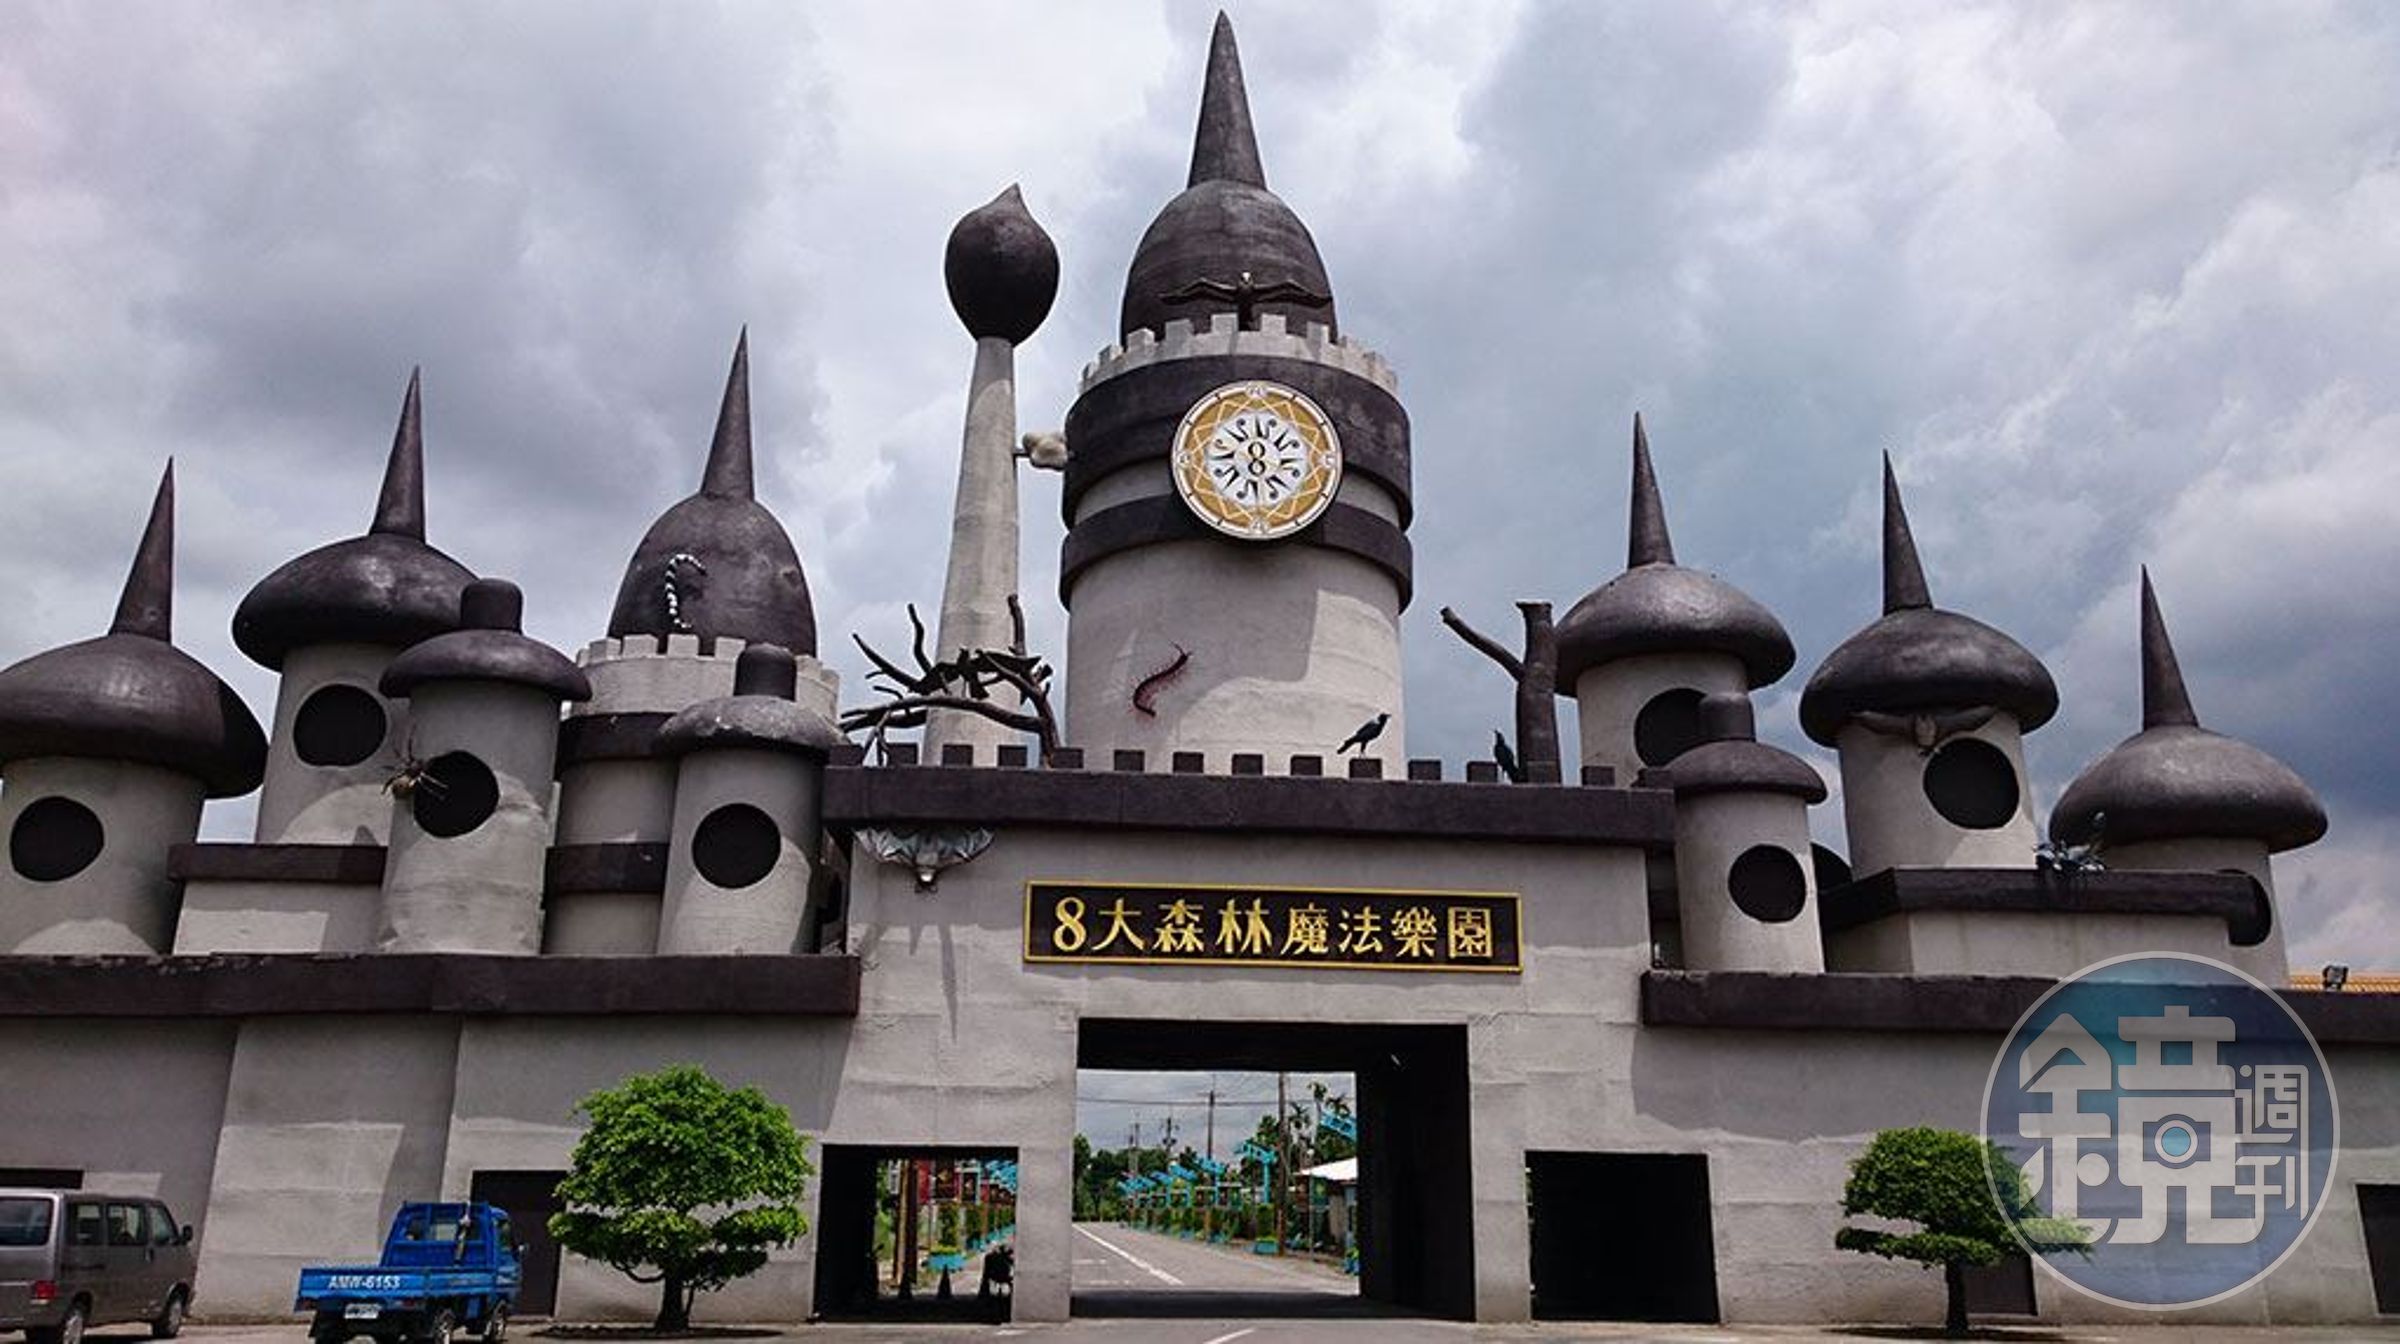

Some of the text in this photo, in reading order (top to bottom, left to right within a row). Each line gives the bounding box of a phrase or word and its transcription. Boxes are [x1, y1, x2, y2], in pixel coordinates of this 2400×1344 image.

[1052, 896, 1493, 959] 8大森林魔法樂園
[327, 1275, 401, 1289] AMW-6153
